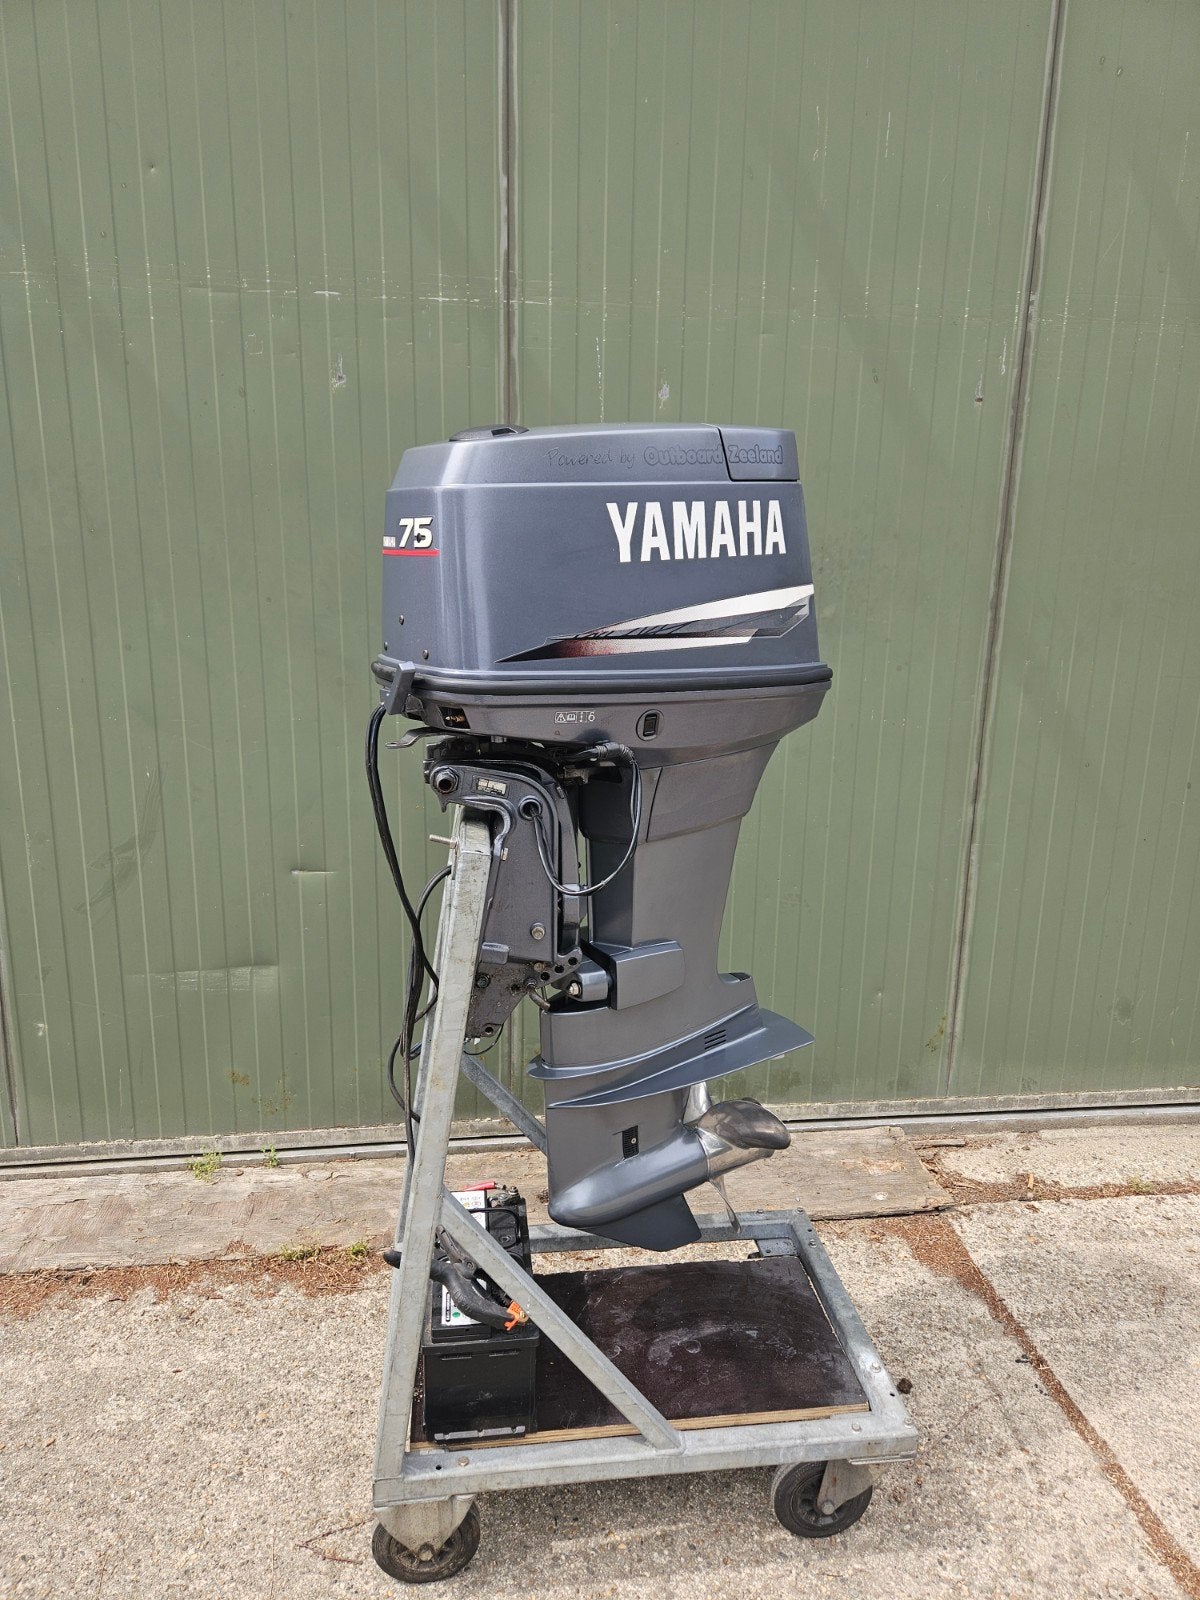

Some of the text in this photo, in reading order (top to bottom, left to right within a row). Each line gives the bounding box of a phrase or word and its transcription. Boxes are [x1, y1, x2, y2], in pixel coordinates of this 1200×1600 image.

[547, 444, 784, 469] Powered by Outboard Zeeland
[399, 517, 433, 549] 75
[606, 500, 787, 563] YAMAHA
